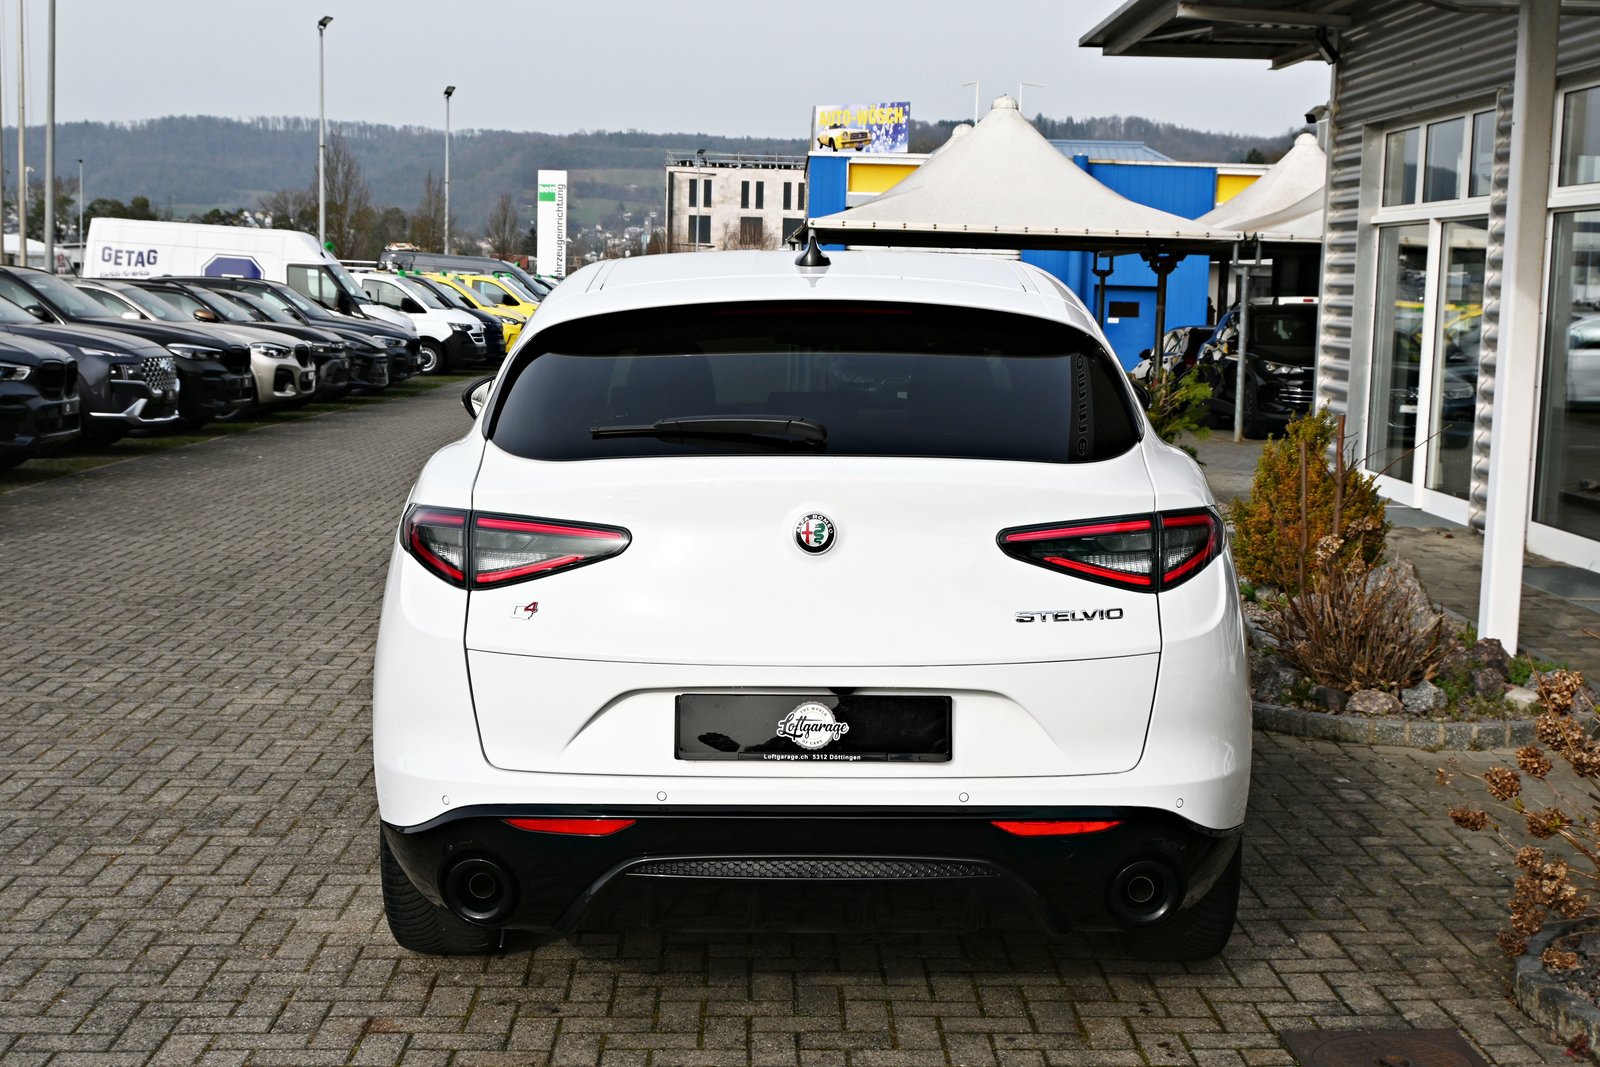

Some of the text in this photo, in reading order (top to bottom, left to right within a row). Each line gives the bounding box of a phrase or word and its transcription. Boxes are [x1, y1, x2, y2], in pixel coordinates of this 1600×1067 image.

[819, 105, 904, 126] AUTO-WÖSCH
[101, 247, 158, 267] GETAG
[812, 514, 834, 534] ROMEO
[1015, 608, 1124, 622] STELVIO
[777, 712, 849, 742] Loftgarage
[763, 753, 809, 761] Loftgarage.ch
[829, 753, 862, 761] Döttingen
